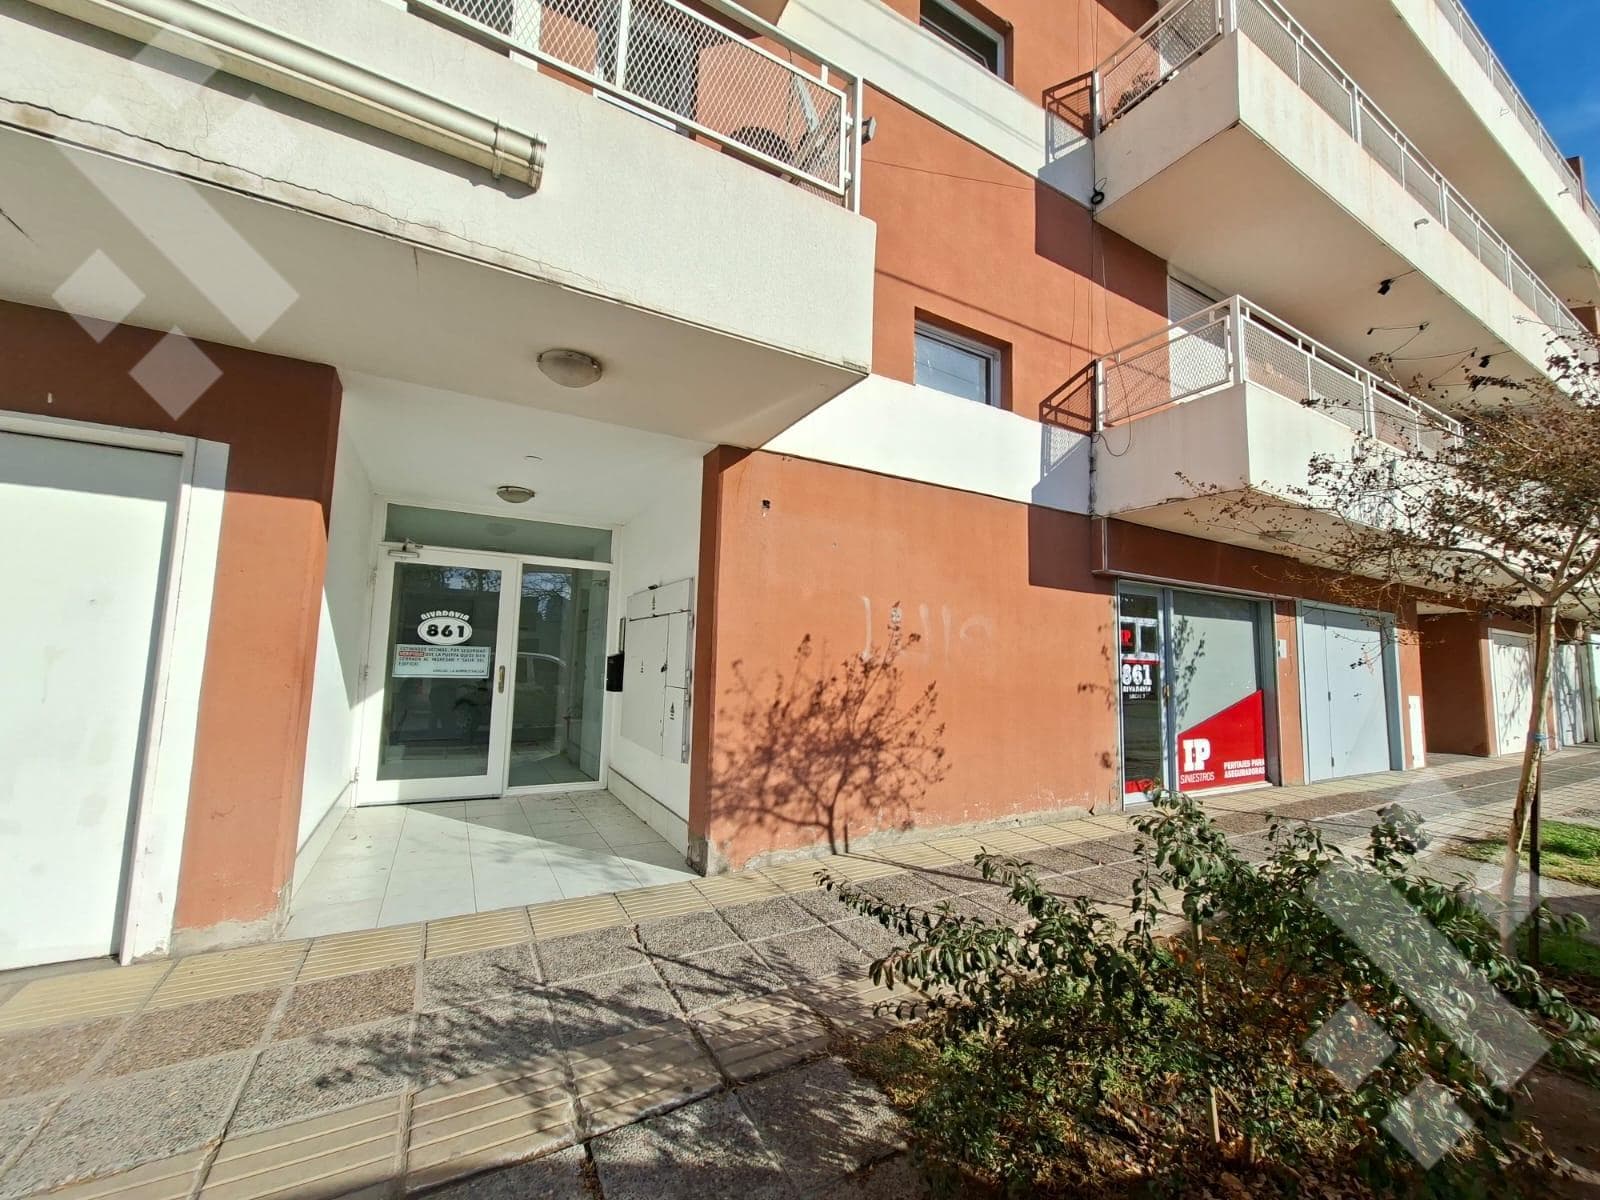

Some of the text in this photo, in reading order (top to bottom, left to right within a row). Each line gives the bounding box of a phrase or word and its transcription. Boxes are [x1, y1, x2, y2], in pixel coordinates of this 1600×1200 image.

[426, 624, 465, 638] 861
[1122, 664, 1152, 685] 861
[1182, 738, 1211, 772] IP
[1223, 760, 1251, 770] PERITAJES
[1180, 771, 1215, 784] SINIESTROS
[1223, 767, 1266, 779] ASEGURADORAS
